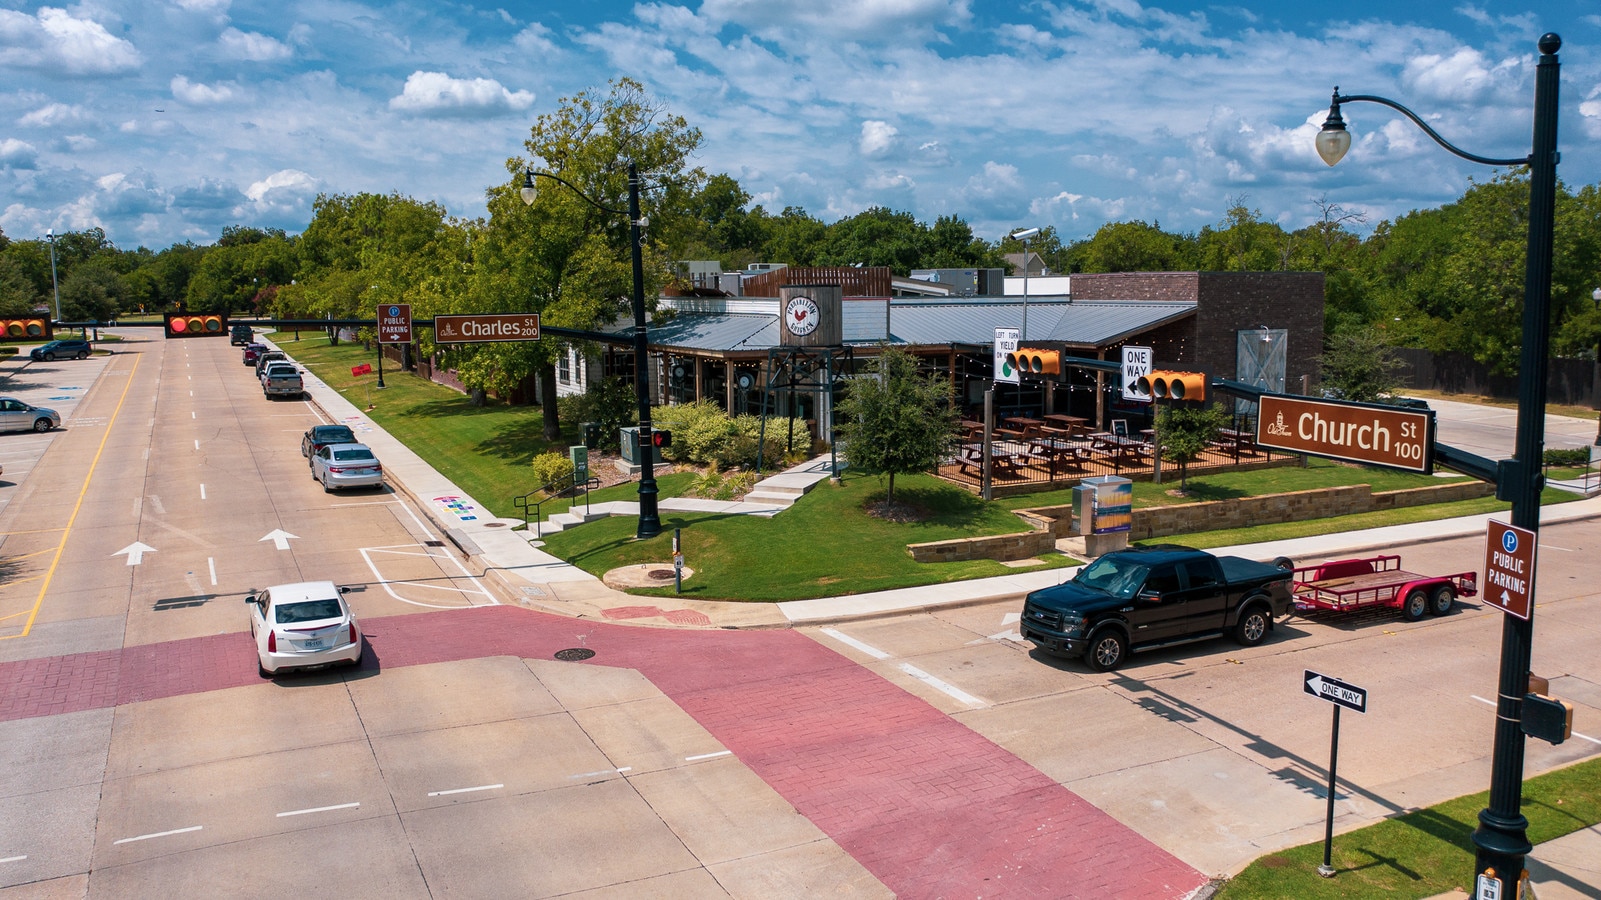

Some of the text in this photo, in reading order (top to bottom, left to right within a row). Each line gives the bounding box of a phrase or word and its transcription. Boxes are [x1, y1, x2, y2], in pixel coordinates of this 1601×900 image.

[461, 320, 520, 336] Charles
[521, 328, 538, 336] 200
[1000, 342, 1014, 350] YIELD
[1128, 352, 1146, 364] ONE
[1126, 365, 1147, 378] WAY
[1298, 412, 1390, 452] Church
[1400, 422, 1416, 438] St
[1394, 442, 1421, 460] 100
[1494, 551, 1524, 574] PUBLIC
[1488, 569, 1526, 594] PARKING
[1322, 683, 1360, 703] ONE WAY
